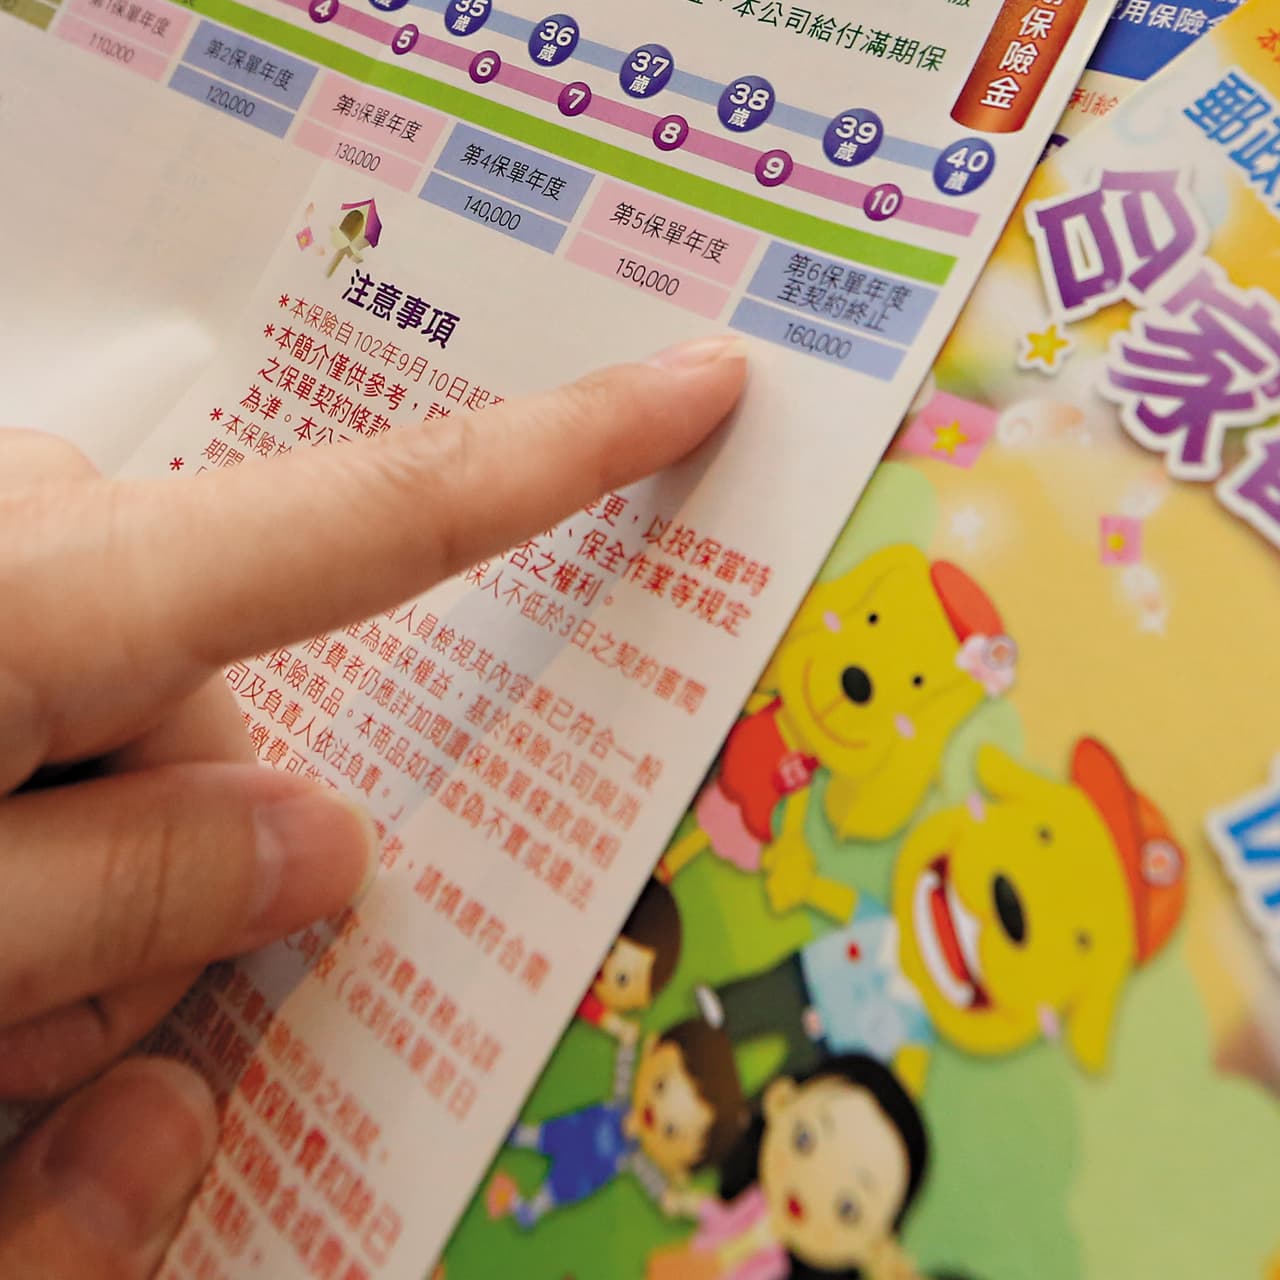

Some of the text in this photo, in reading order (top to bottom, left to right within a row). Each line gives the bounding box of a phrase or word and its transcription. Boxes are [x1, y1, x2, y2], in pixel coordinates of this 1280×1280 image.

[397, 30, 414, 49] 5
[538, 20, 575, 46] 36
[87, 31, 135, 65] 110,000
[536, 42, 556, 63] 歲
[204, 38, 295, 92] 第2保單年度
[477, 58, 495, 77] 6
[631, 51, 669, 78] 37
[628, 74, 651, 95] 歲
[729, 83, 770, 111] 38
[204, 87, 256, 119] 120,000
[567, 88, 586, 110] 7
[331, 93, 423, 143] 第3保單年度
[727, 107, 749, 128] 歲
[835, 116, 877, 145] 39
[661, 122, 681, 144] 8
[334, 142, 381, 172] 130,000
[832, 140, 857, 162] 歲
[945, 146, 989, 174] 40
[459, 143, 568, 202] 第4保單年度
[764, 157, 785, 179] 9
[943, 169, 967, 192] 歲
[462, 194, 523, 233] 140,000
[870, 190, 899, 215] 10
[609, 202, 730, 265] 第5保單年度
[614, 257, 680, 297] 150,000
[781, 252, 913, 313] 第6保單年度
[341, 268, 461, 350] 注意事項
[776, 280, 886, 333] 至契約終止
[784, 322, 853, 361] 160,000
[258, 356, 392, 439] 之保單契約條款
